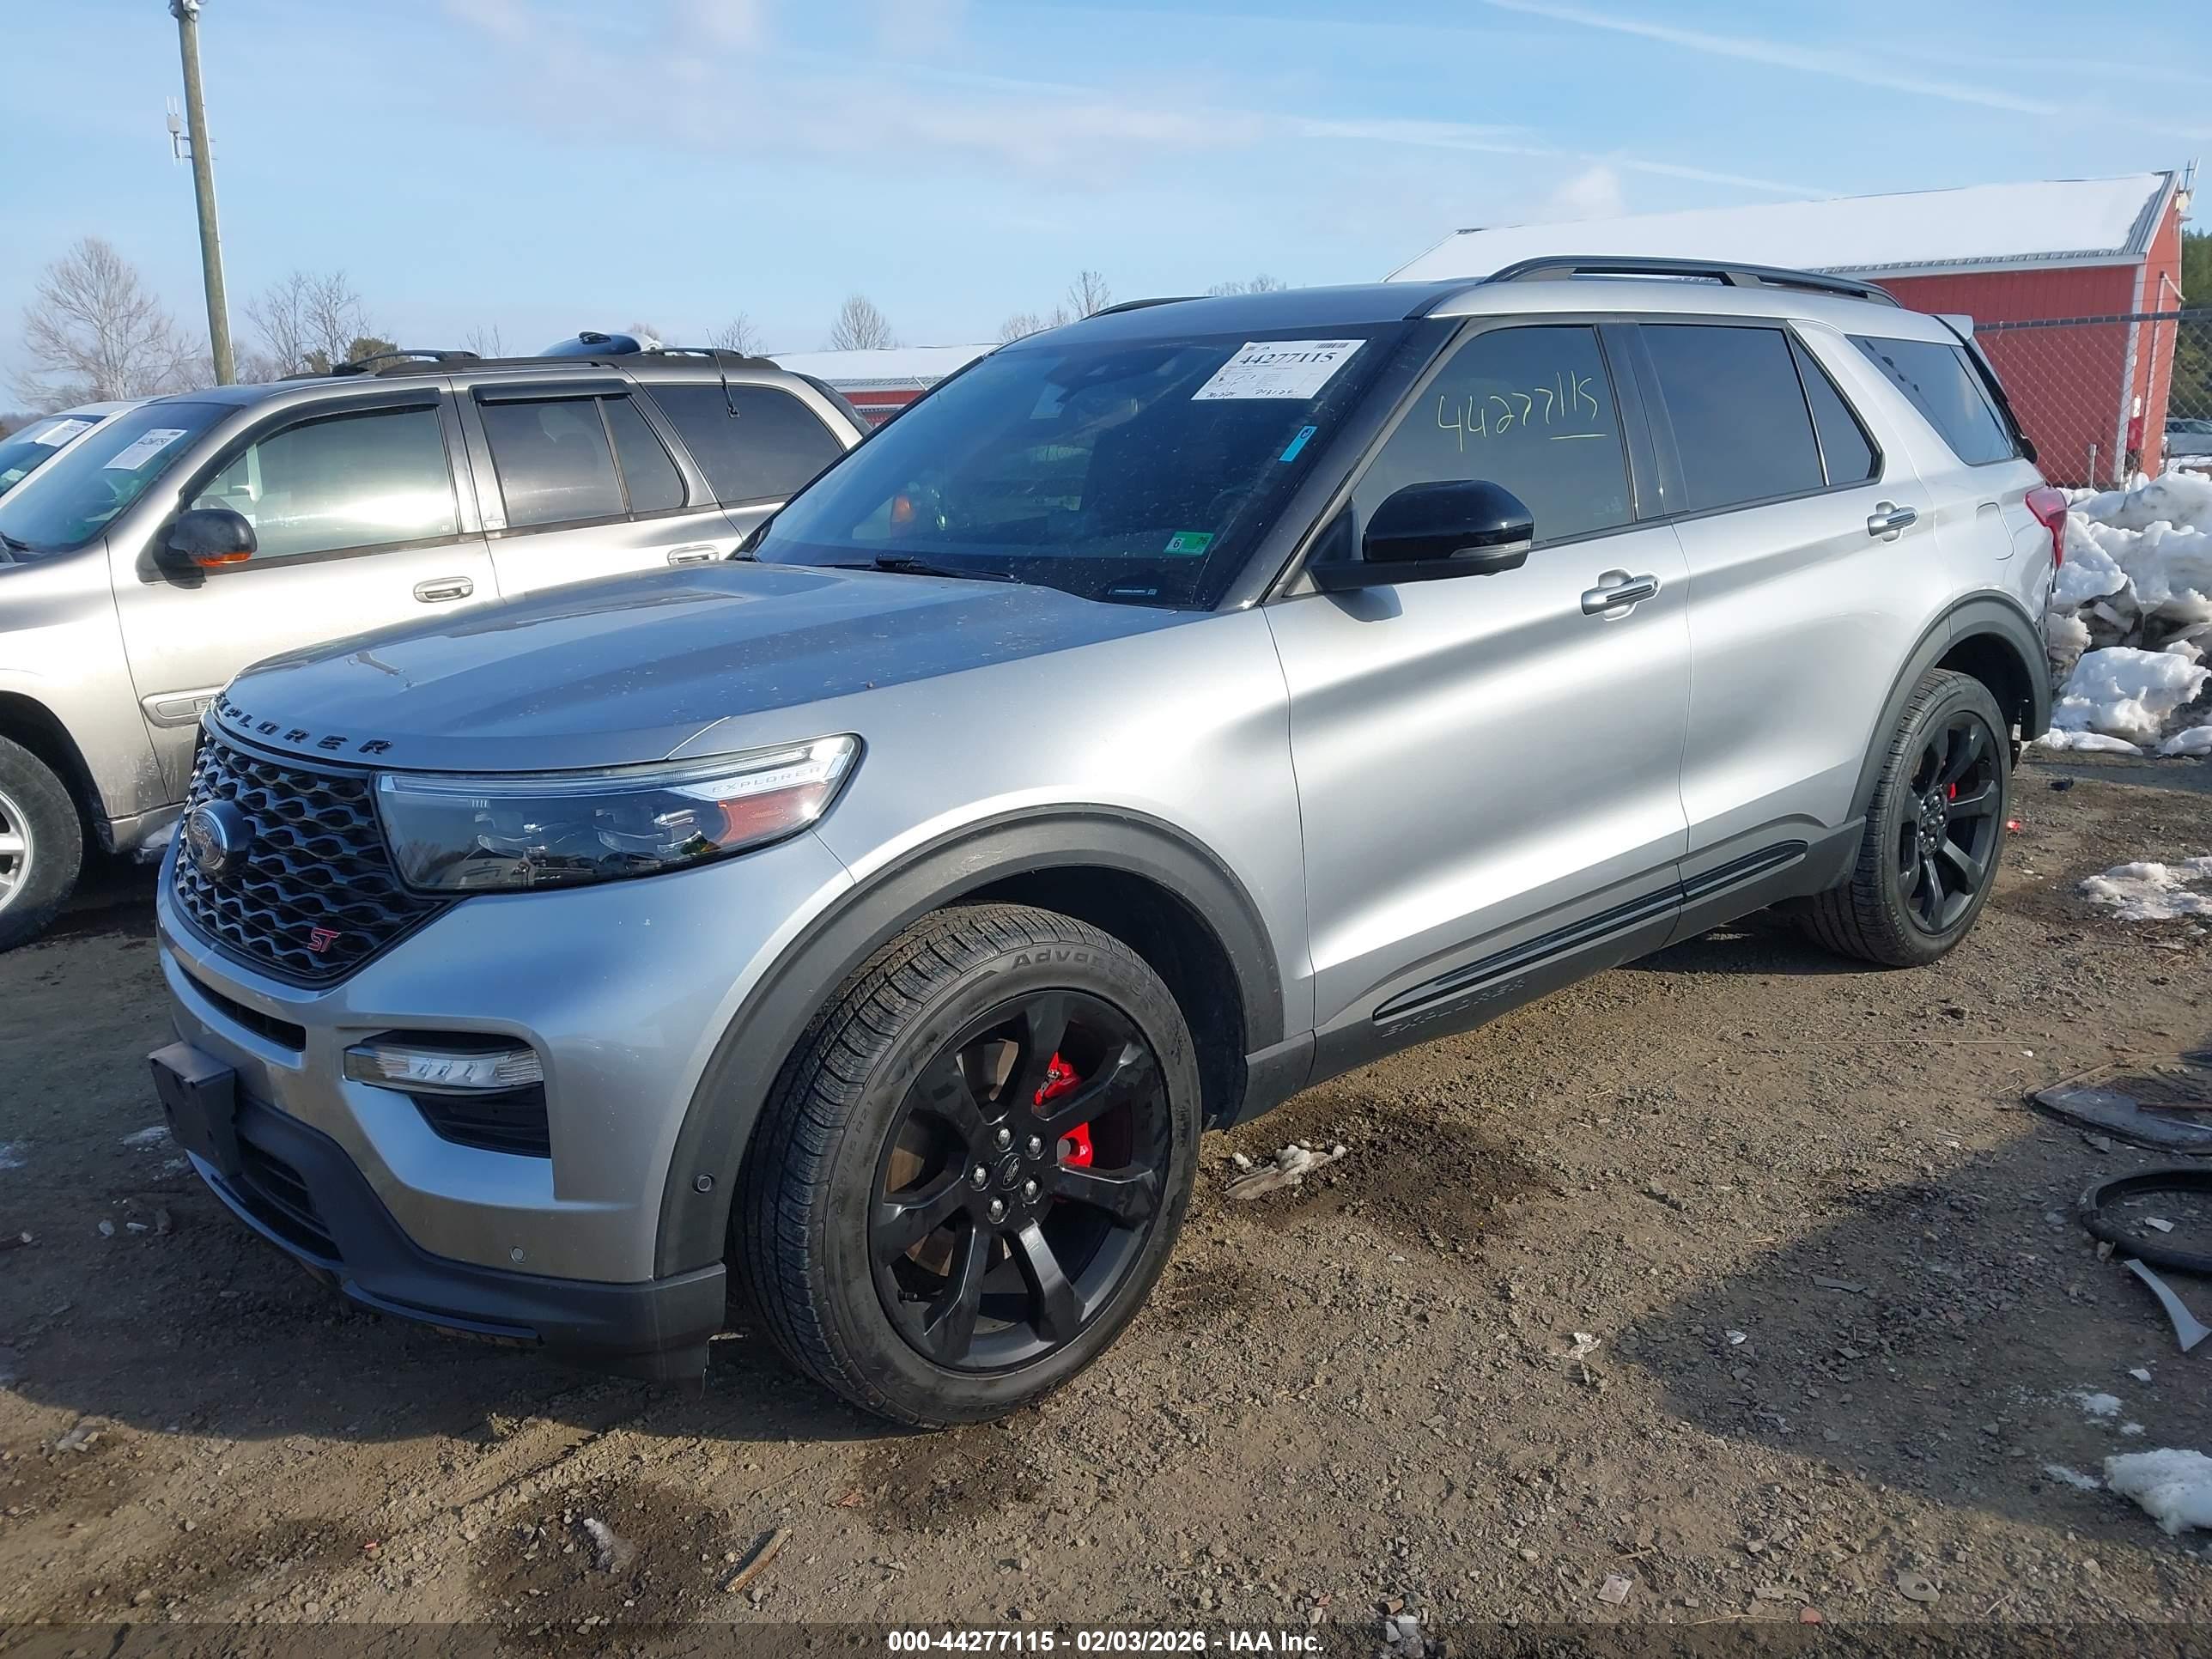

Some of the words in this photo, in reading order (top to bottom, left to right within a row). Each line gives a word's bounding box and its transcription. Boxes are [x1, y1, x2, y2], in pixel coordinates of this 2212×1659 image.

[1239, 351, 1338, 365] 44277115
[1437, 370, 1598, 453] 44277115
[1173, 538, 1182, 549] 6
[712, 767, 820, 793] EXPLORER
[307, 927, 341, 952] ST
